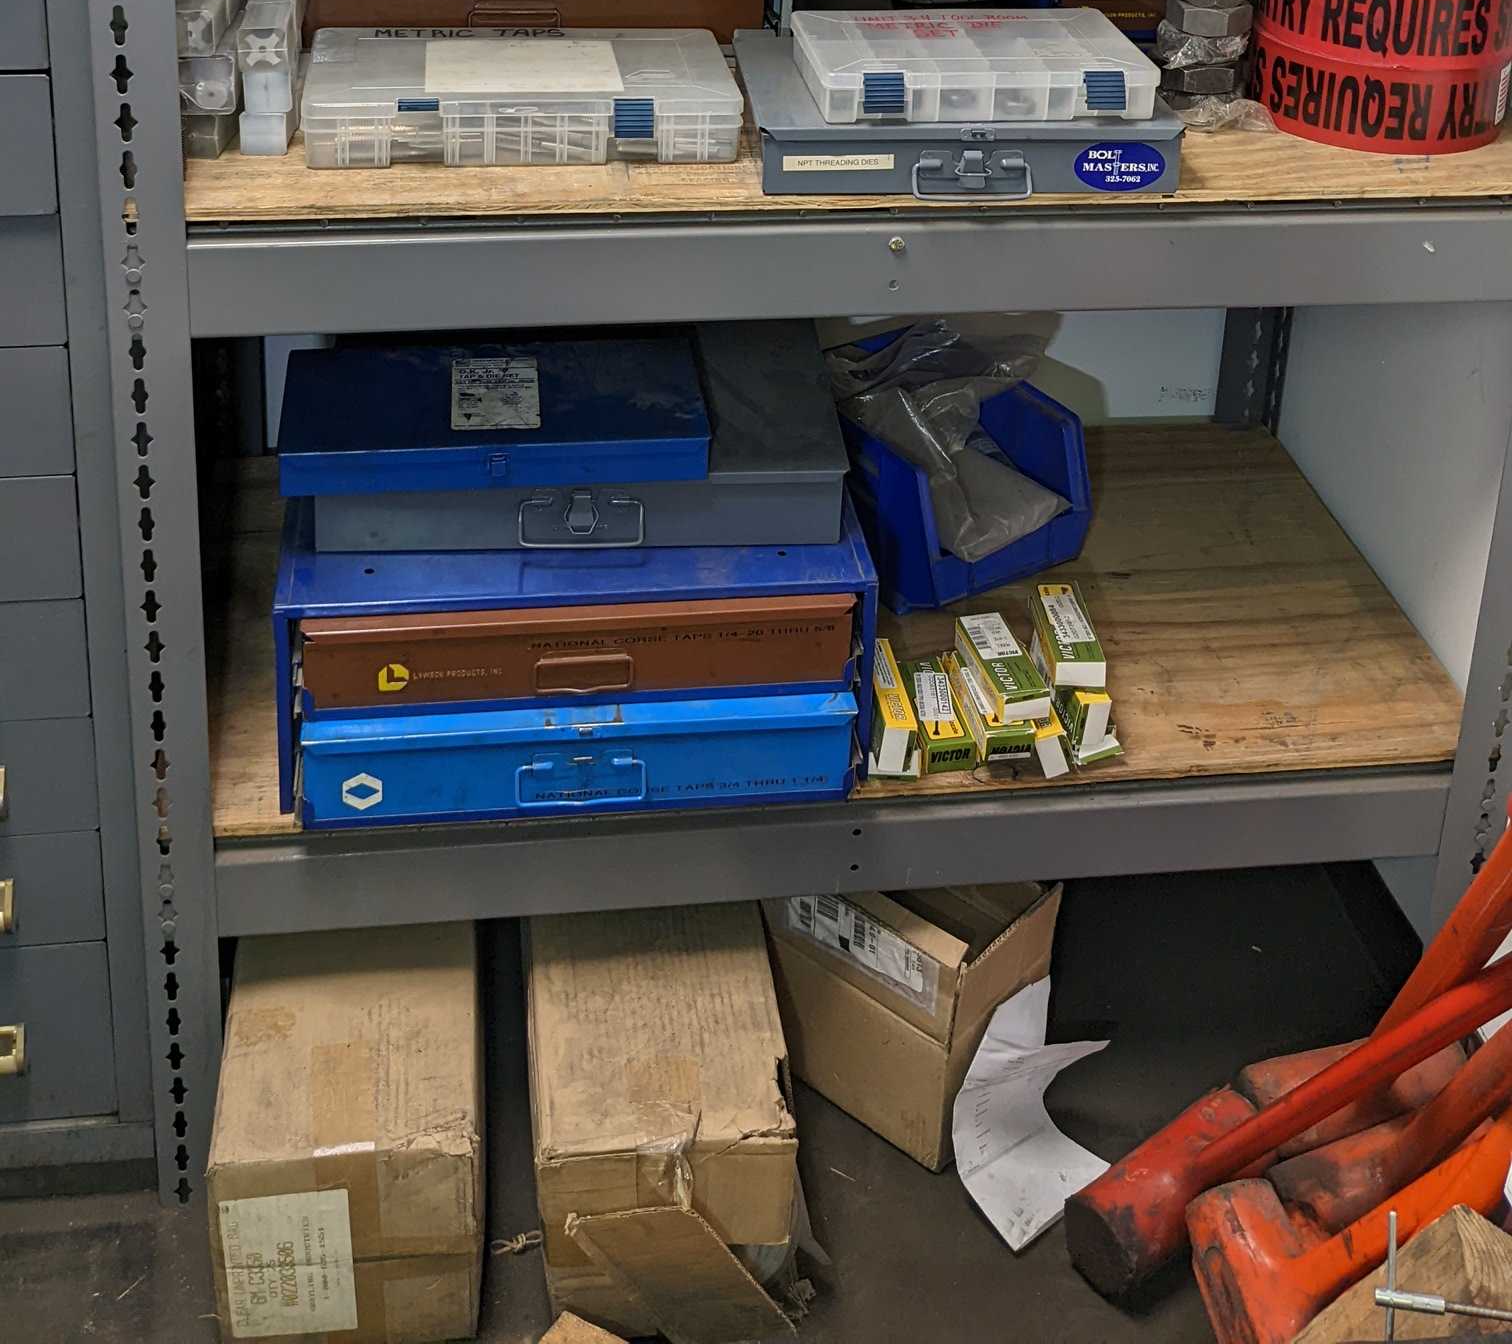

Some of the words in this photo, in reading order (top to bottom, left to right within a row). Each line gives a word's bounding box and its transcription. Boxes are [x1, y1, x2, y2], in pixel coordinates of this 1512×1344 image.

[374, 28, 475, 40] METRIC
[498, 28, 566, 40] TAPS
[1271, 56, 1433, 142] REQUIRES
[797, 159, 814, 168] NPT
[815, 159, 860, 168] THREADING
[861, 158, 879, 167] DIES
[1105, 175, 1141, 183] 325-7062
[530, 639, 606, 650] NATIONAL
[991, 657, 1017, 693] VICTOR
[930, 747, 971, 764] VICTOR
